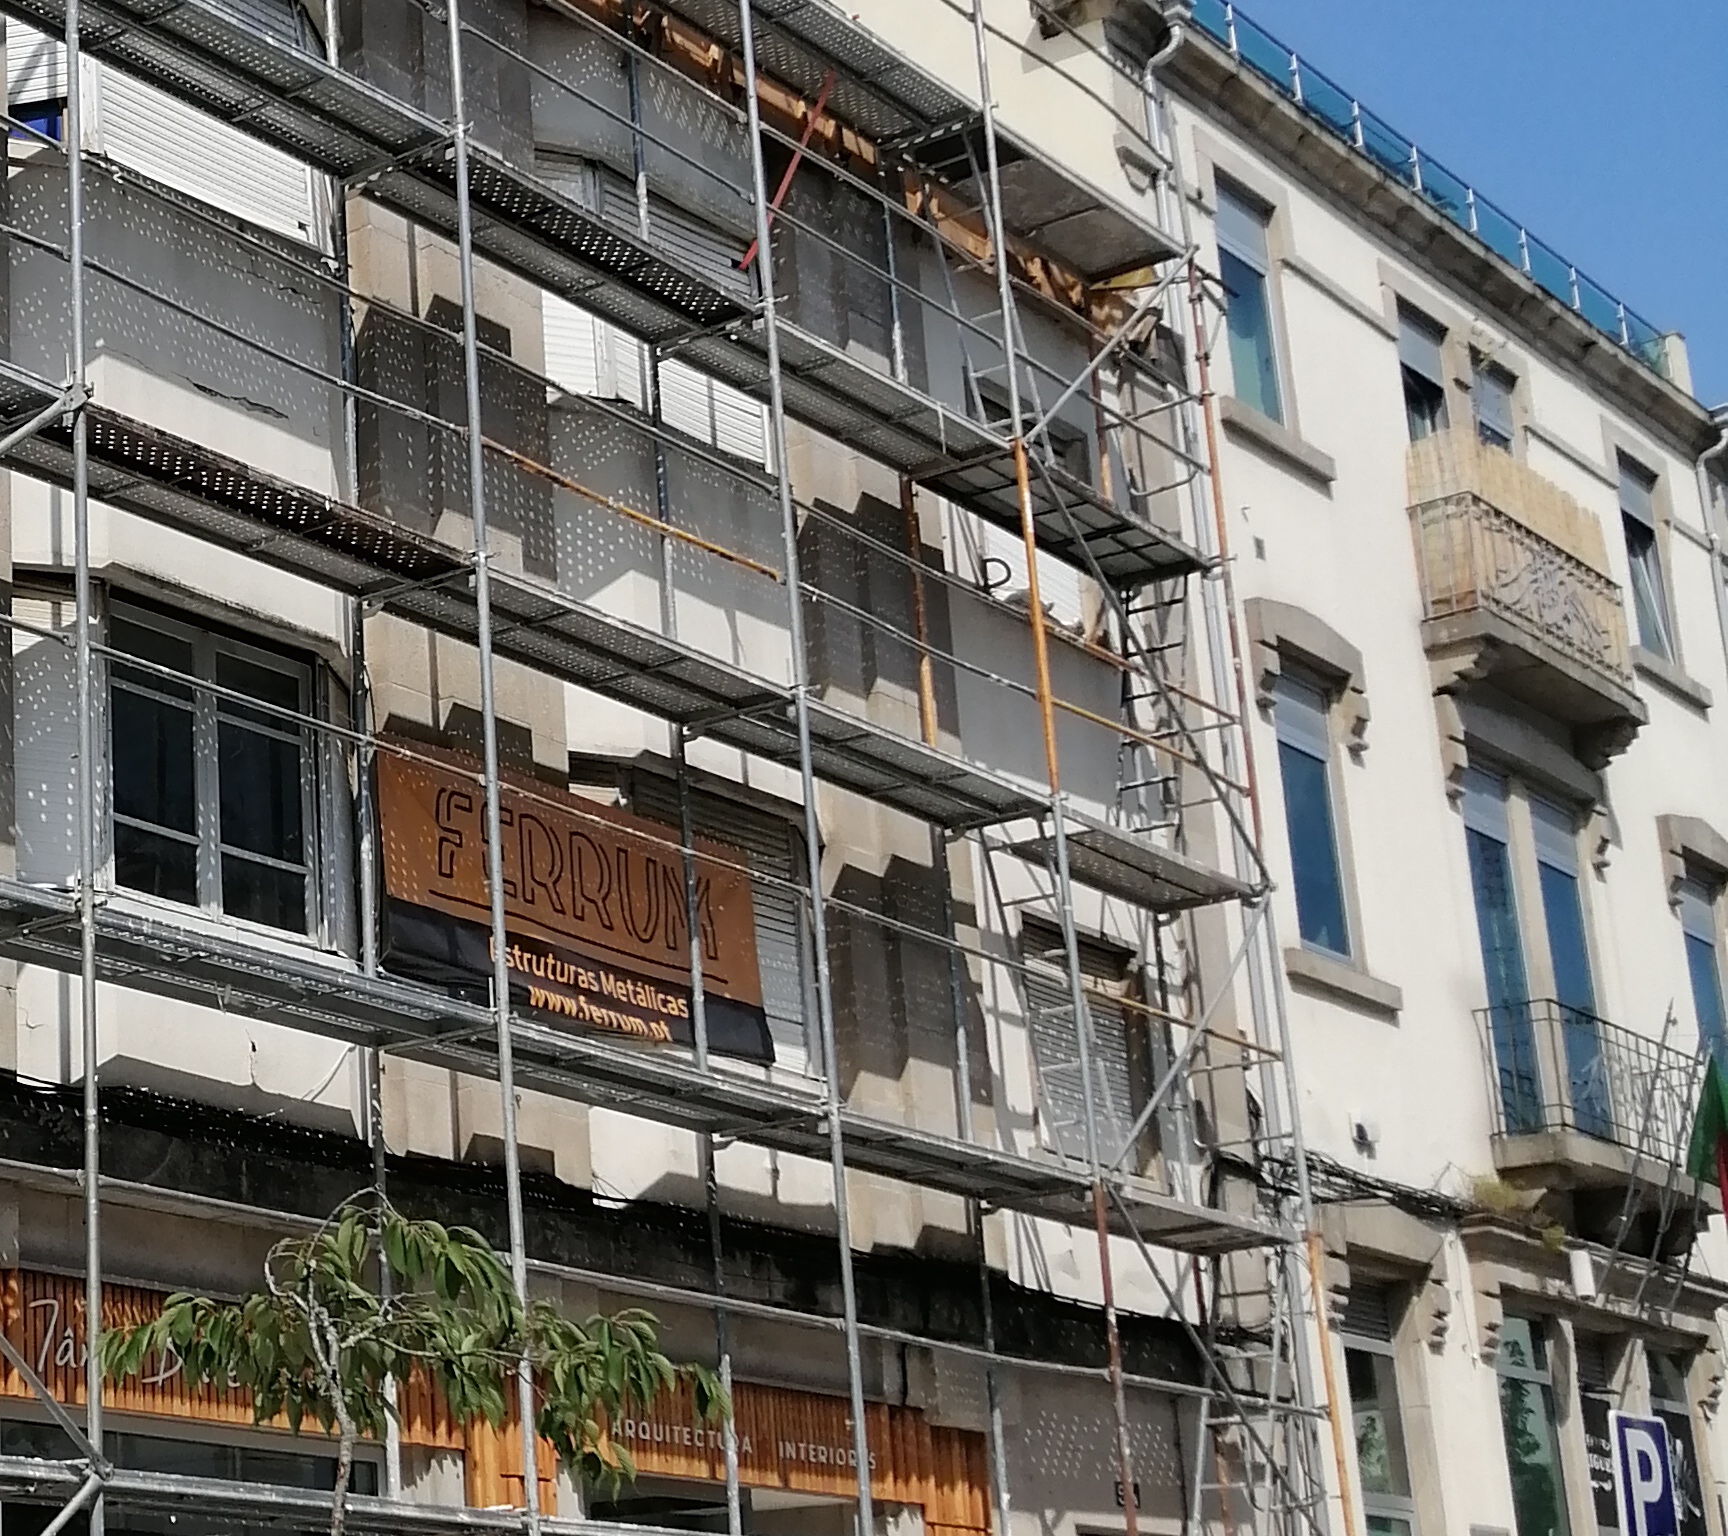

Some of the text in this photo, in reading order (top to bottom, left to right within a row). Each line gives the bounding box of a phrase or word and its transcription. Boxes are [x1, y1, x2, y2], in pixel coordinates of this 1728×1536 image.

[434, 787, 720, 961] FERRUM
[528, 985, 672, 1043] www.ferrum.pt
[599, 970, 689, 1018] Metálicas
[778, 1440, 877, 1470] INTERIORS
